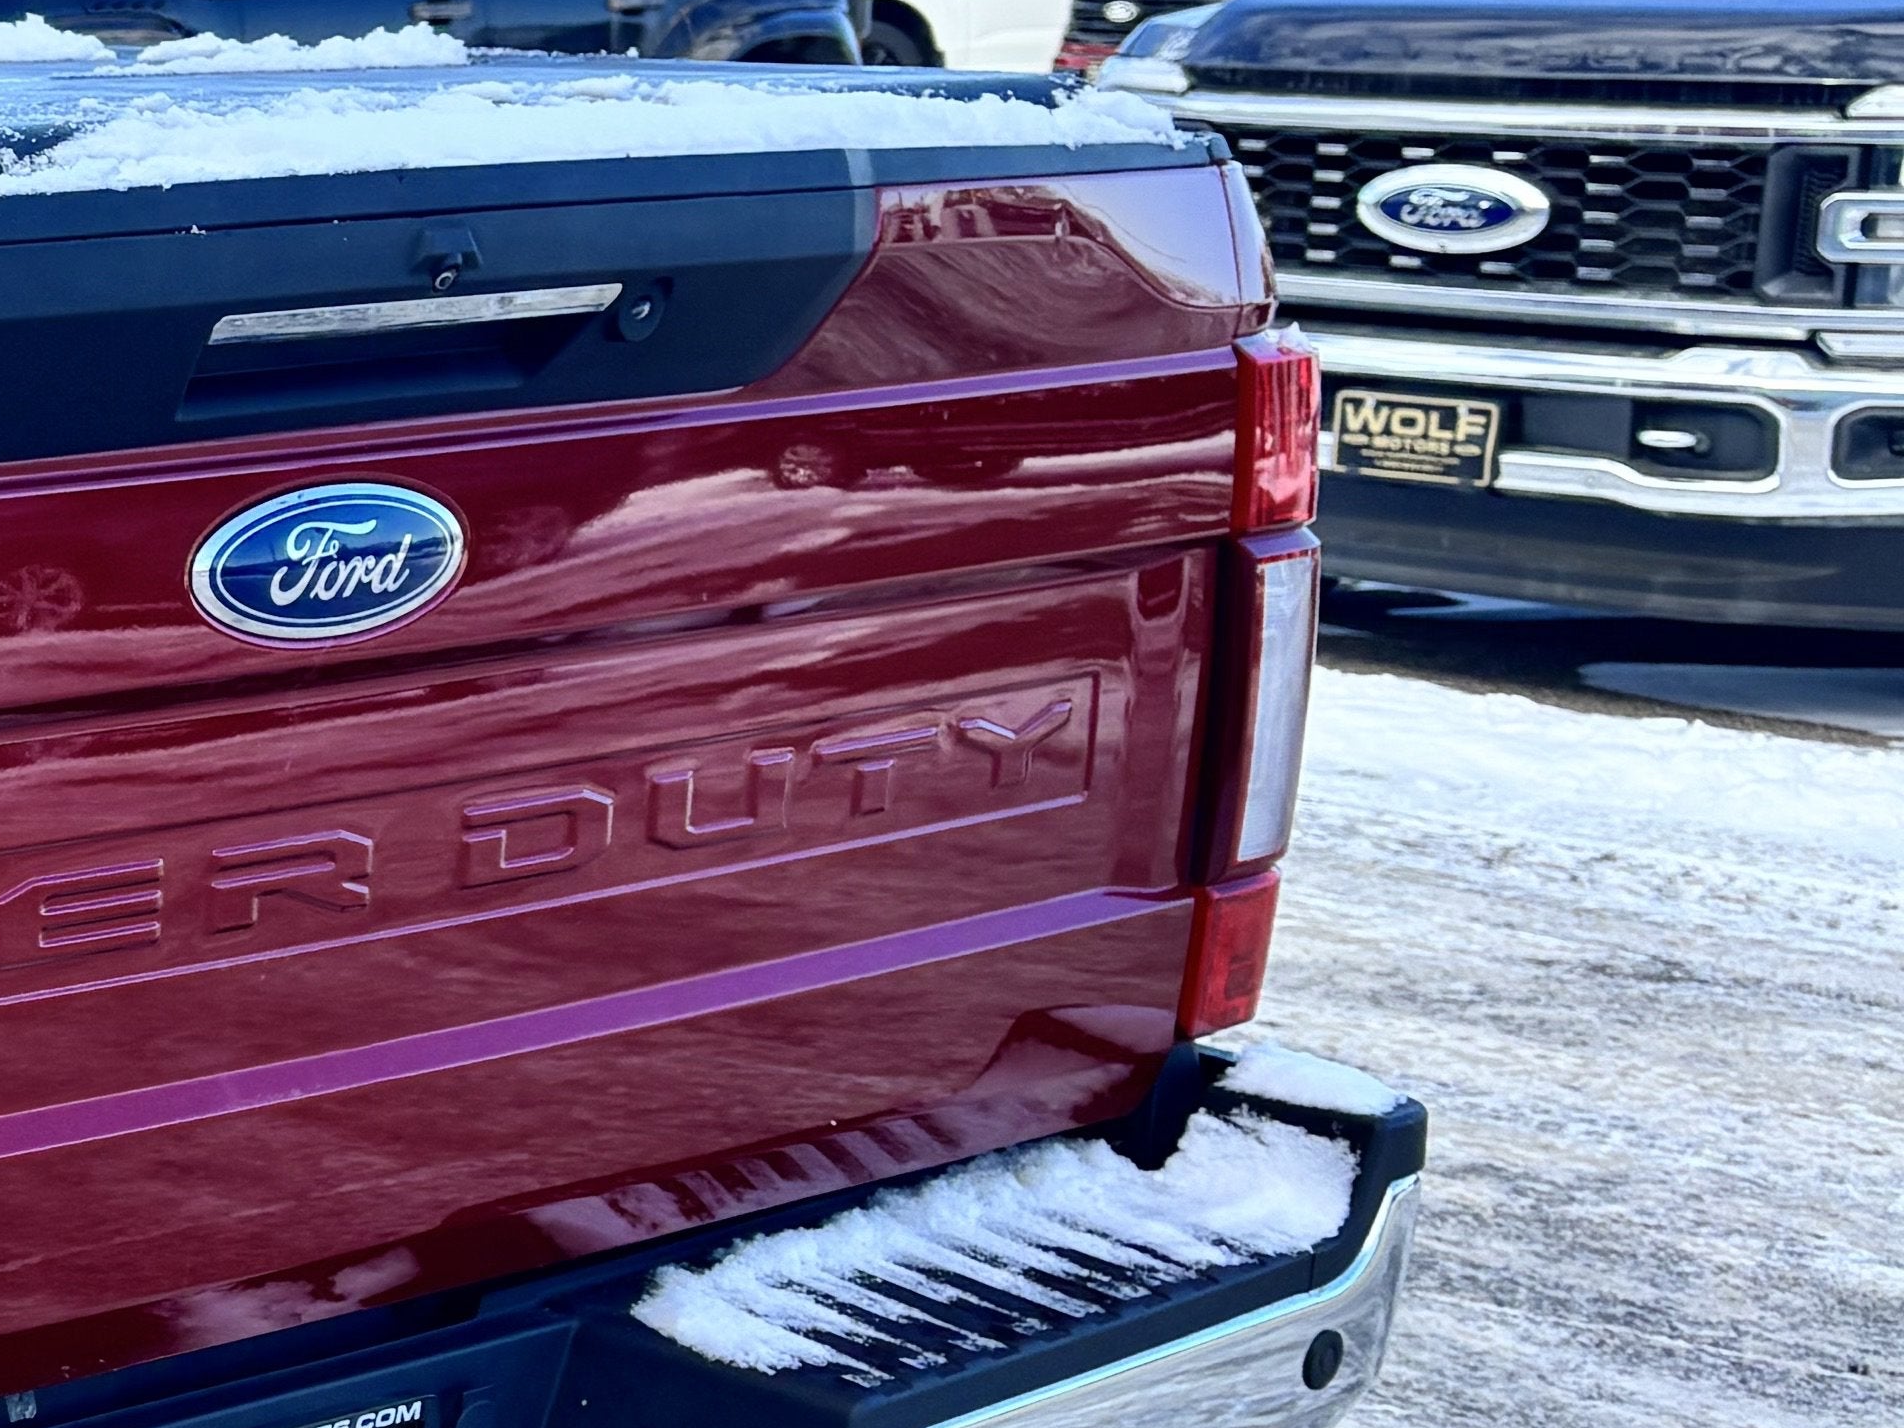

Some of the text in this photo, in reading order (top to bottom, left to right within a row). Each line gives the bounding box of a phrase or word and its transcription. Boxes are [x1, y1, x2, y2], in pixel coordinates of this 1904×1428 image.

[1400, 187, 1493, 228] Ford
[1345, 402, 1488, 442] WOLF
[1371, 435, 1451, 456] MOTORS
[269, 519, 410, 606] Ford
[458, 699, 1072, 890] DUTY
